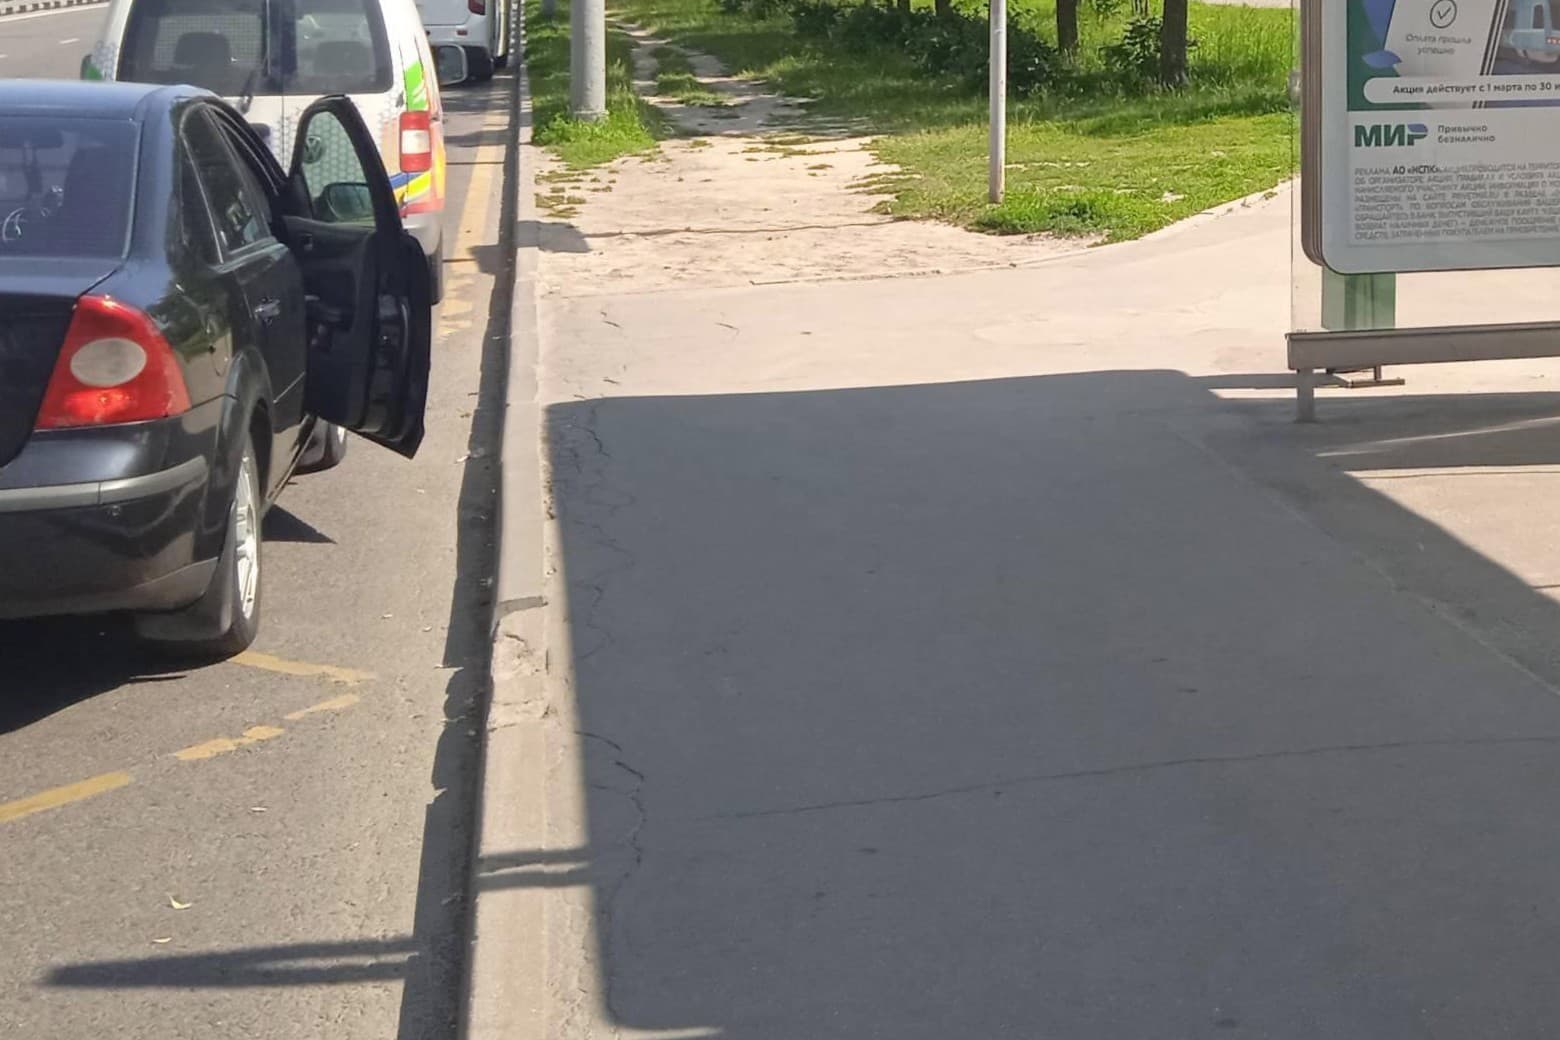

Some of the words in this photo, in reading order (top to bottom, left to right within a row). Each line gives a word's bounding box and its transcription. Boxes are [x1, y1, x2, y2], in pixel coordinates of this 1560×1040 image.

[1392, 84, 1424, 96] Акция
[1426, 82, 1476, 96] действует
[1479, 85, 1485, 93] с
[1493, 84, 1523, 95] марта
[1525, 83, 1537, 92] по
[1540, 81, 1552, 92] 30
[1354, 123, 1429, 147] МИР
[1437, 125, 1488, 134] Привычно
[1437, 134, 1496, 143] безналично
[1392, 164, 1406, 175] АО
